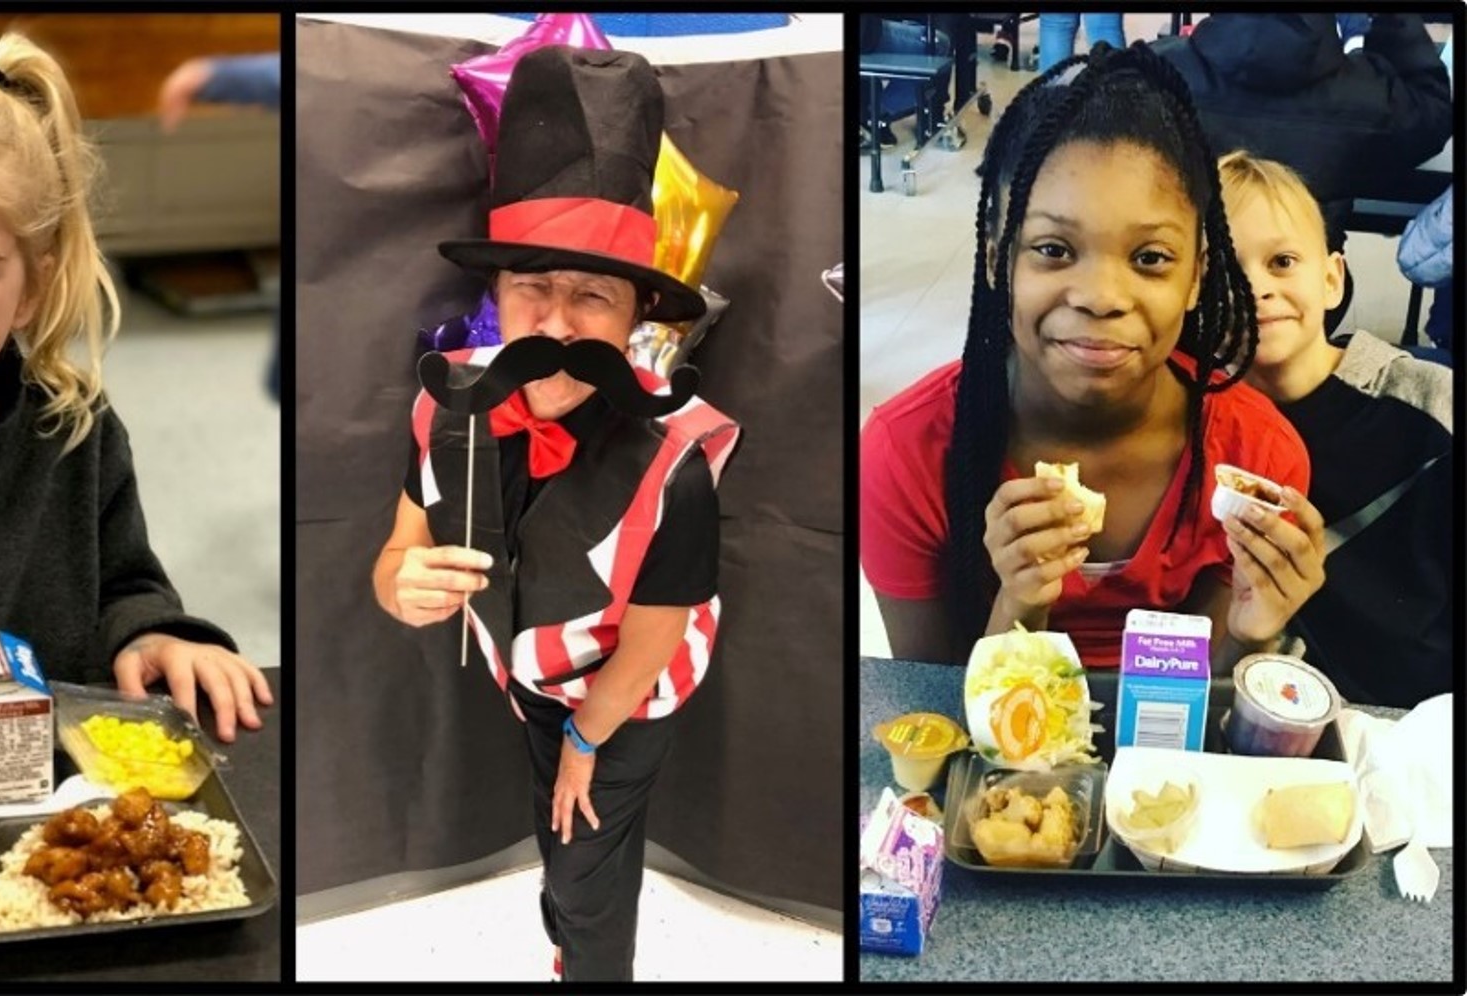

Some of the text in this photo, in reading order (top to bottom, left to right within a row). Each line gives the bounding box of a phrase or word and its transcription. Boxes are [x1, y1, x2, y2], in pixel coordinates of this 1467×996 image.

[1138, 636, 1196, 648] Fat Free Milk
[1134, 655, 1199, 671] DairyPure
